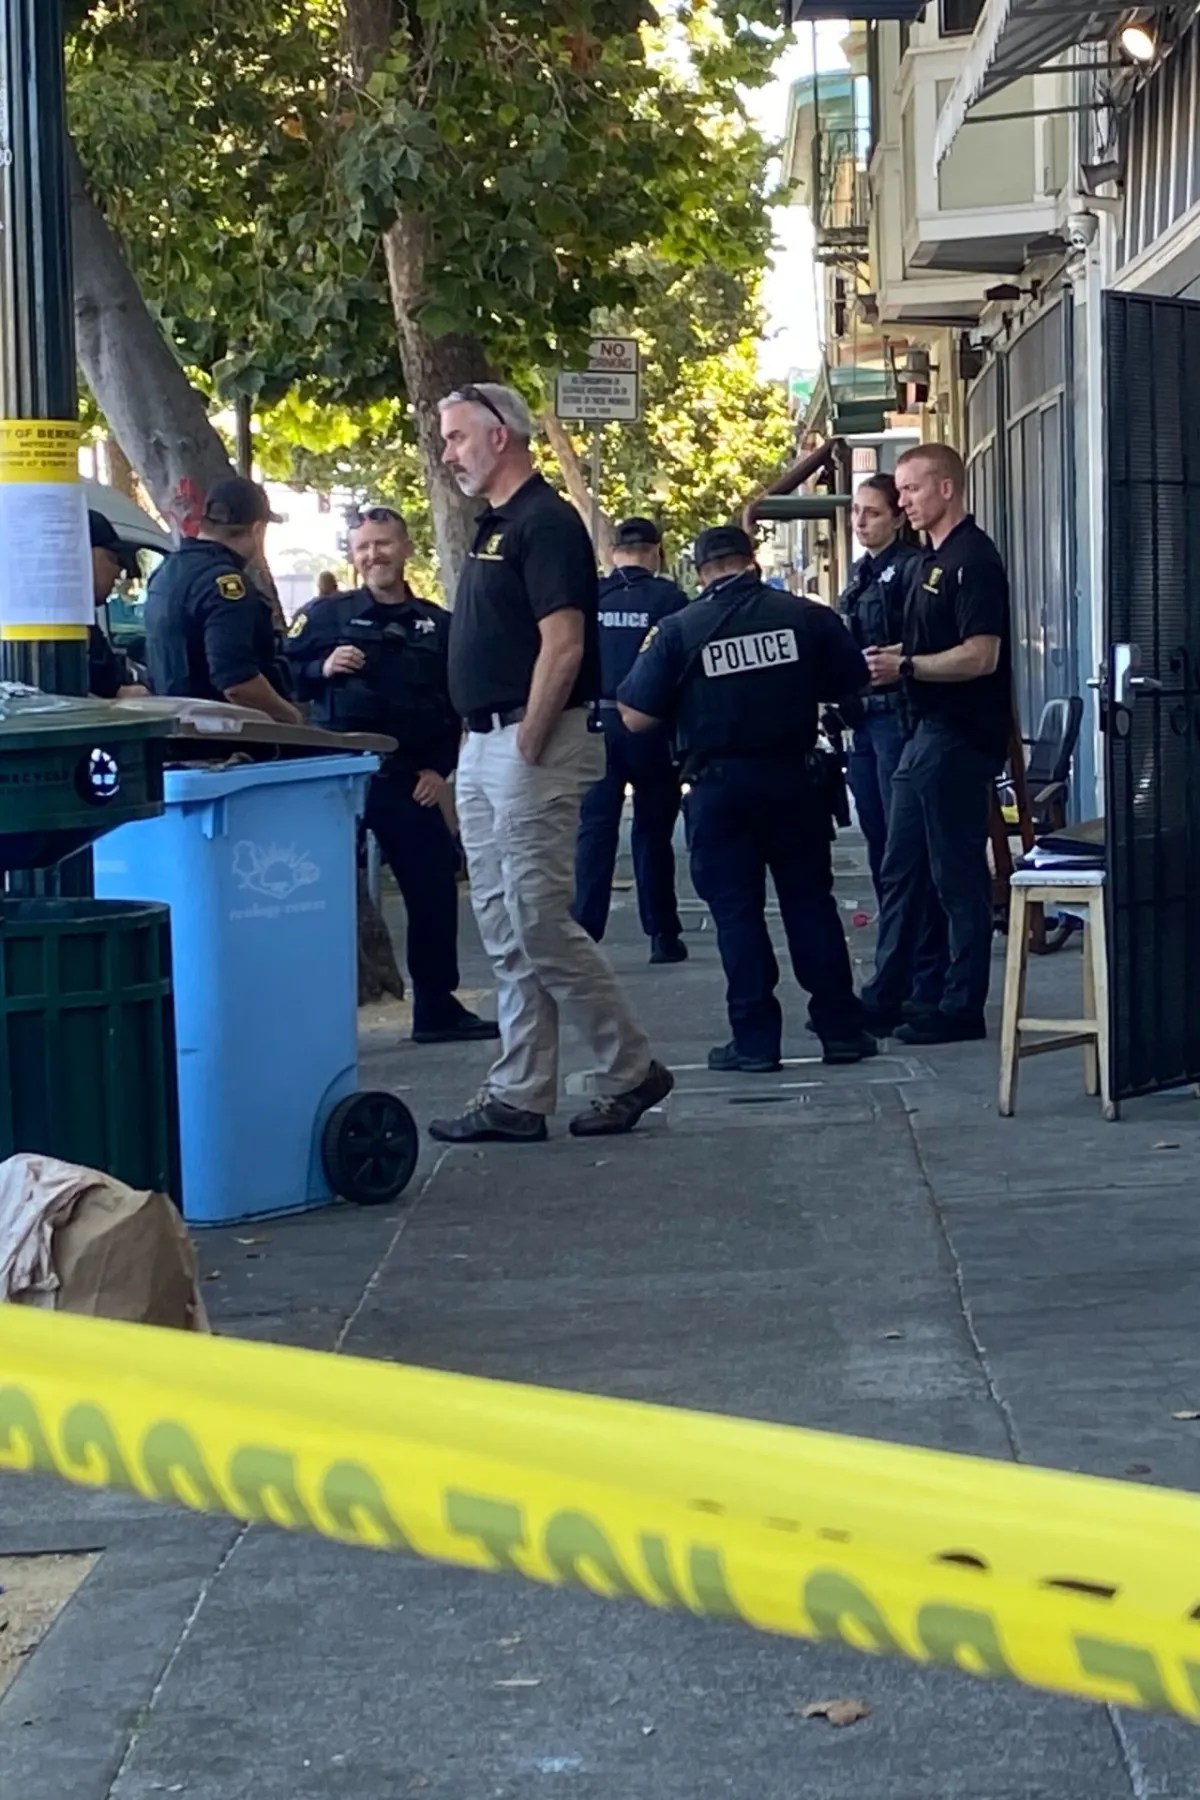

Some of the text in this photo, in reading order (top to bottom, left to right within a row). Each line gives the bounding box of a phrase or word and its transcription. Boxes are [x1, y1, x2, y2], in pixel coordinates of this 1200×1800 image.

[600, 343, 626, 357] NO
[15, 428, 32, 438] OF
[597, 612, 648, 627] POLICE
[709, 632, 791, 672] POLICE
